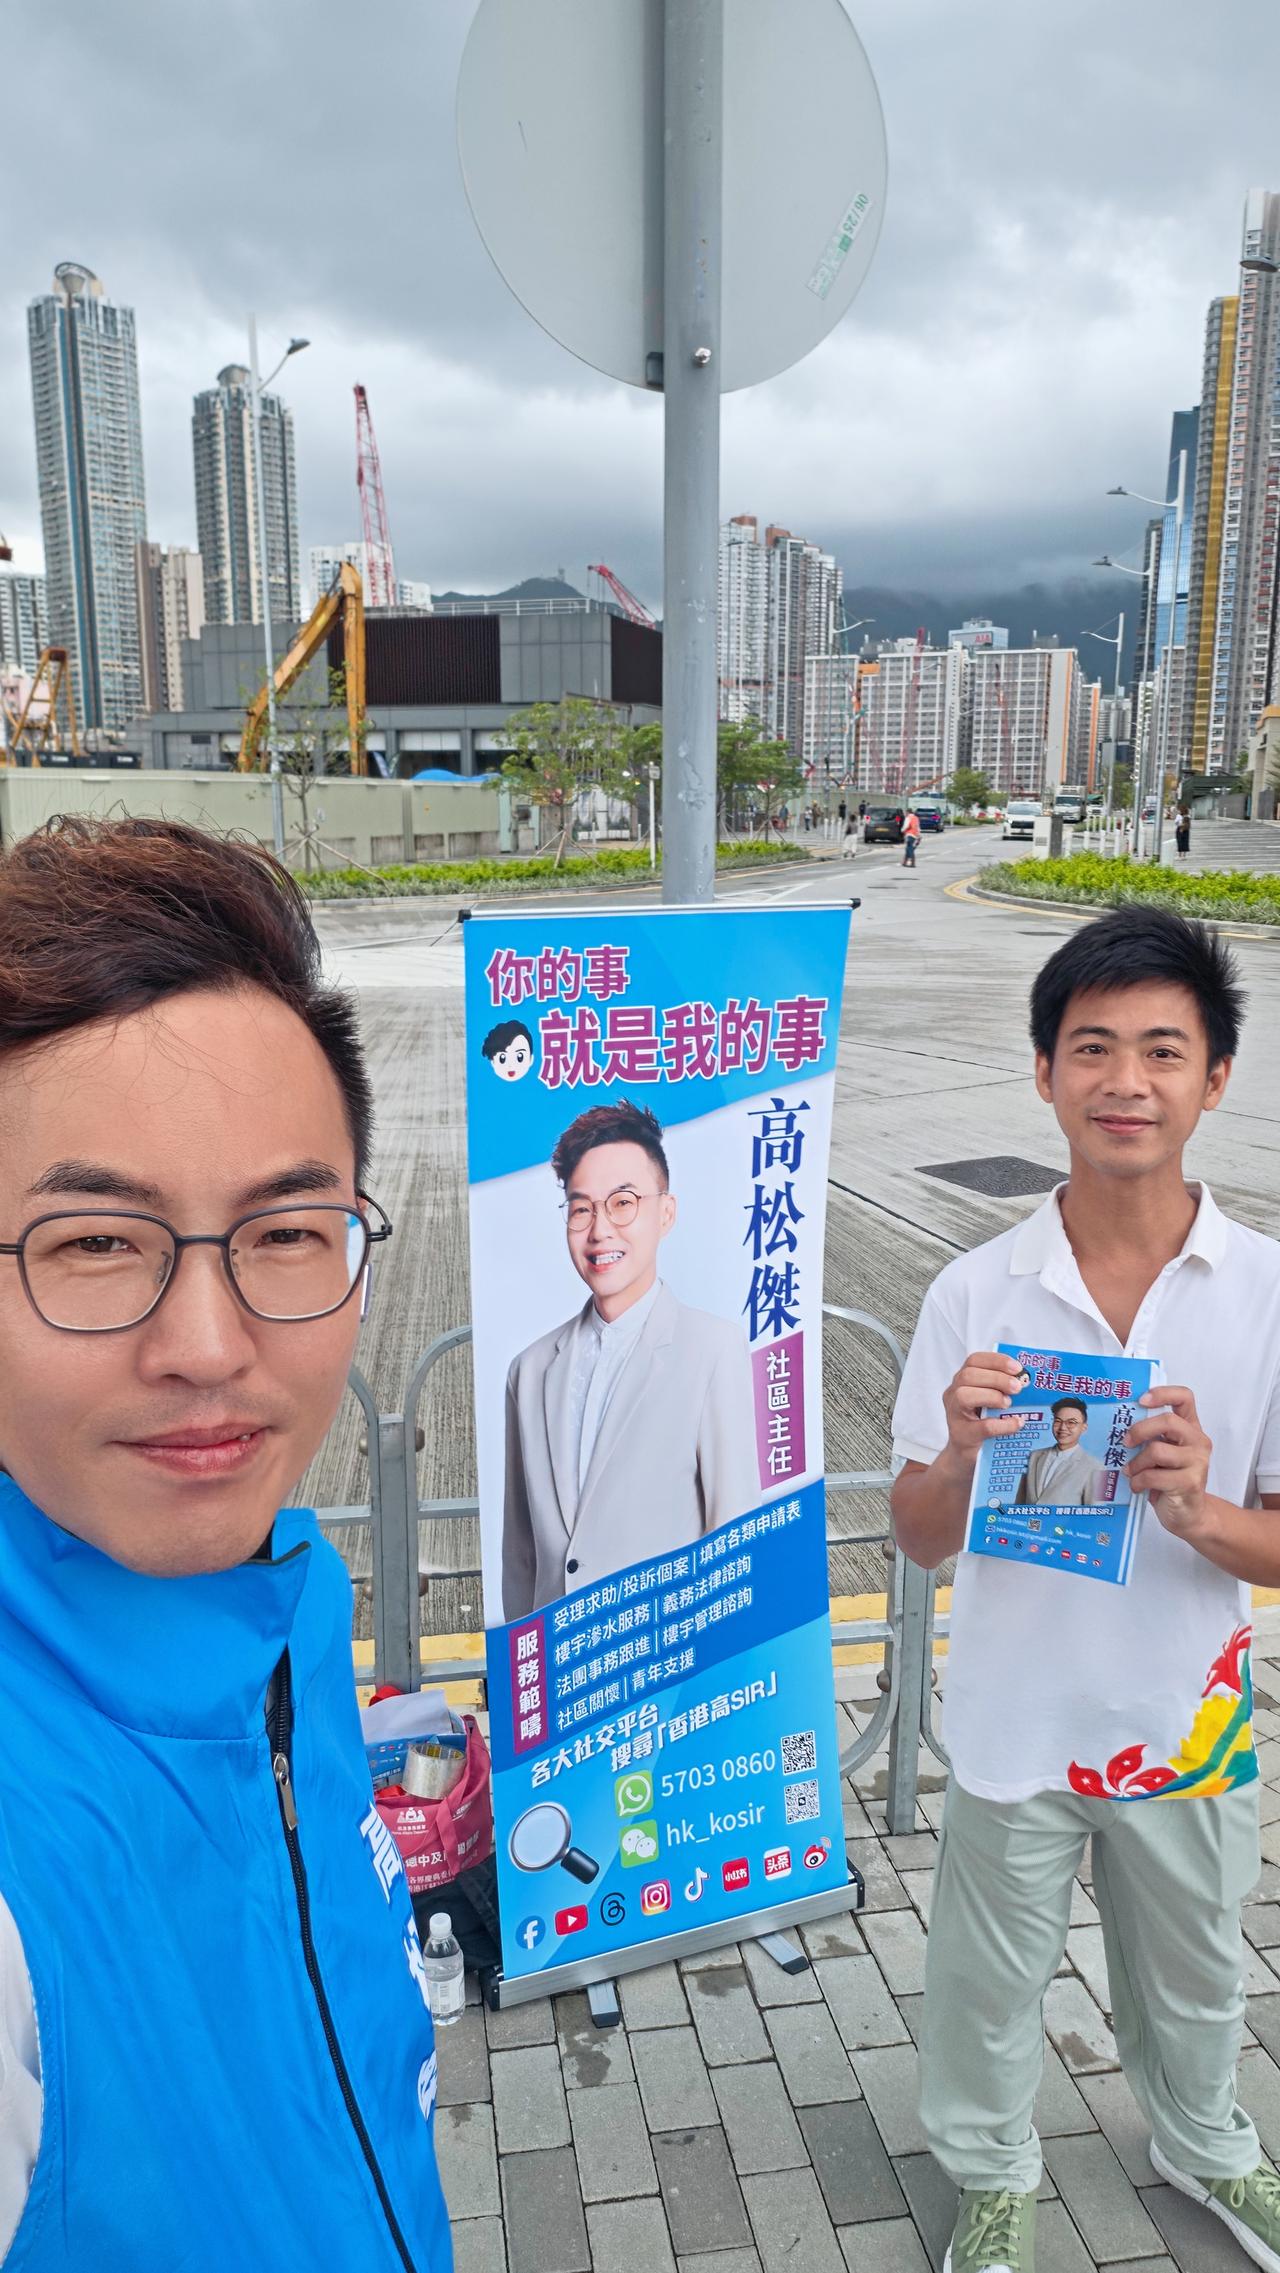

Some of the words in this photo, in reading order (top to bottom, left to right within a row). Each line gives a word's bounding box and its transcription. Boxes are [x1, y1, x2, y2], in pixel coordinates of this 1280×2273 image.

[485, 945, 630, 1005] 你的事
[539, 997, 828, 1087] 就是我的事
[742, 1097, 811, 1342] 高松傑
[766, 1351, 792, 1476] 社區主任
[1034, 1370, 1132, 1399] 就是我的事
[700, 1500, 800, 1564] 填寫各類申請表
[662, 1554, 751, 1615] 義務法律諮詢
[556, 1635, 651, 1698] 法團事務跟進
[663, 1587, 752, 1646] 樓宇管理諮詢
[517, 1629, 542, 1741] 服務範疇
[557, 1682, 620, 1731] 社區關懷
[632, 1648, 695, 1692] 青年支援
[531, 1703, 658, 1788] 各大社交平台
[661, 1764, 716, 1797] 5703
[722, 1749, 776, 1781] 0860
[666, 1802, 766, 1847] hk_kosir
[766, 1853, 789, 1873] 头条
